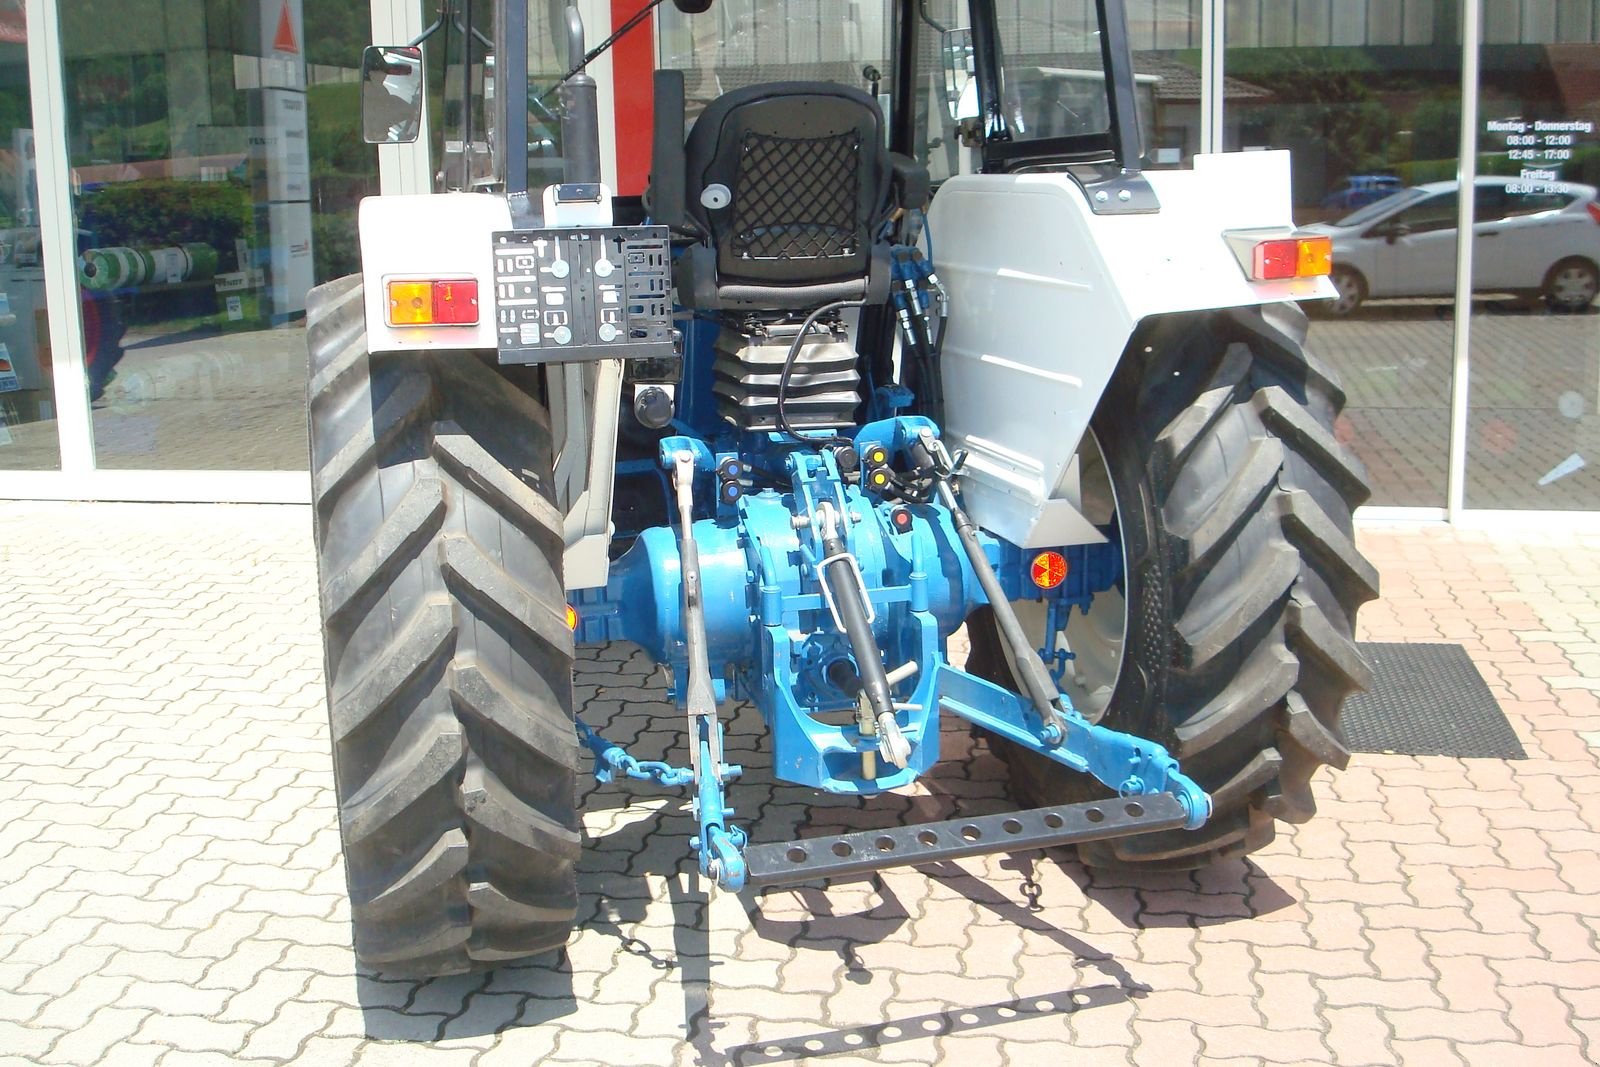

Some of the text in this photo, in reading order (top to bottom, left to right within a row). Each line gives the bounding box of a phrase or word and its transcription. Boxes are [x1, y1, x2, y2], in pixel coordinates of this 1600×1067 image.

[1487, 121, 1525, 133] Montag
[1534, 122, 1592, 133] Donnerstag
[1506, 135, 1535, 145] 08:00
[1544, 135, 1571, 145] 12:00
[1507, 149, 1534, 159] 12:45
[1544, 149, 1570, 159] 17:00
[1520, 169, 1556, 180] Freitag
[1505, 184, 1533, 194] 08:00
[1543, 184, 1569, 194] 13:30
